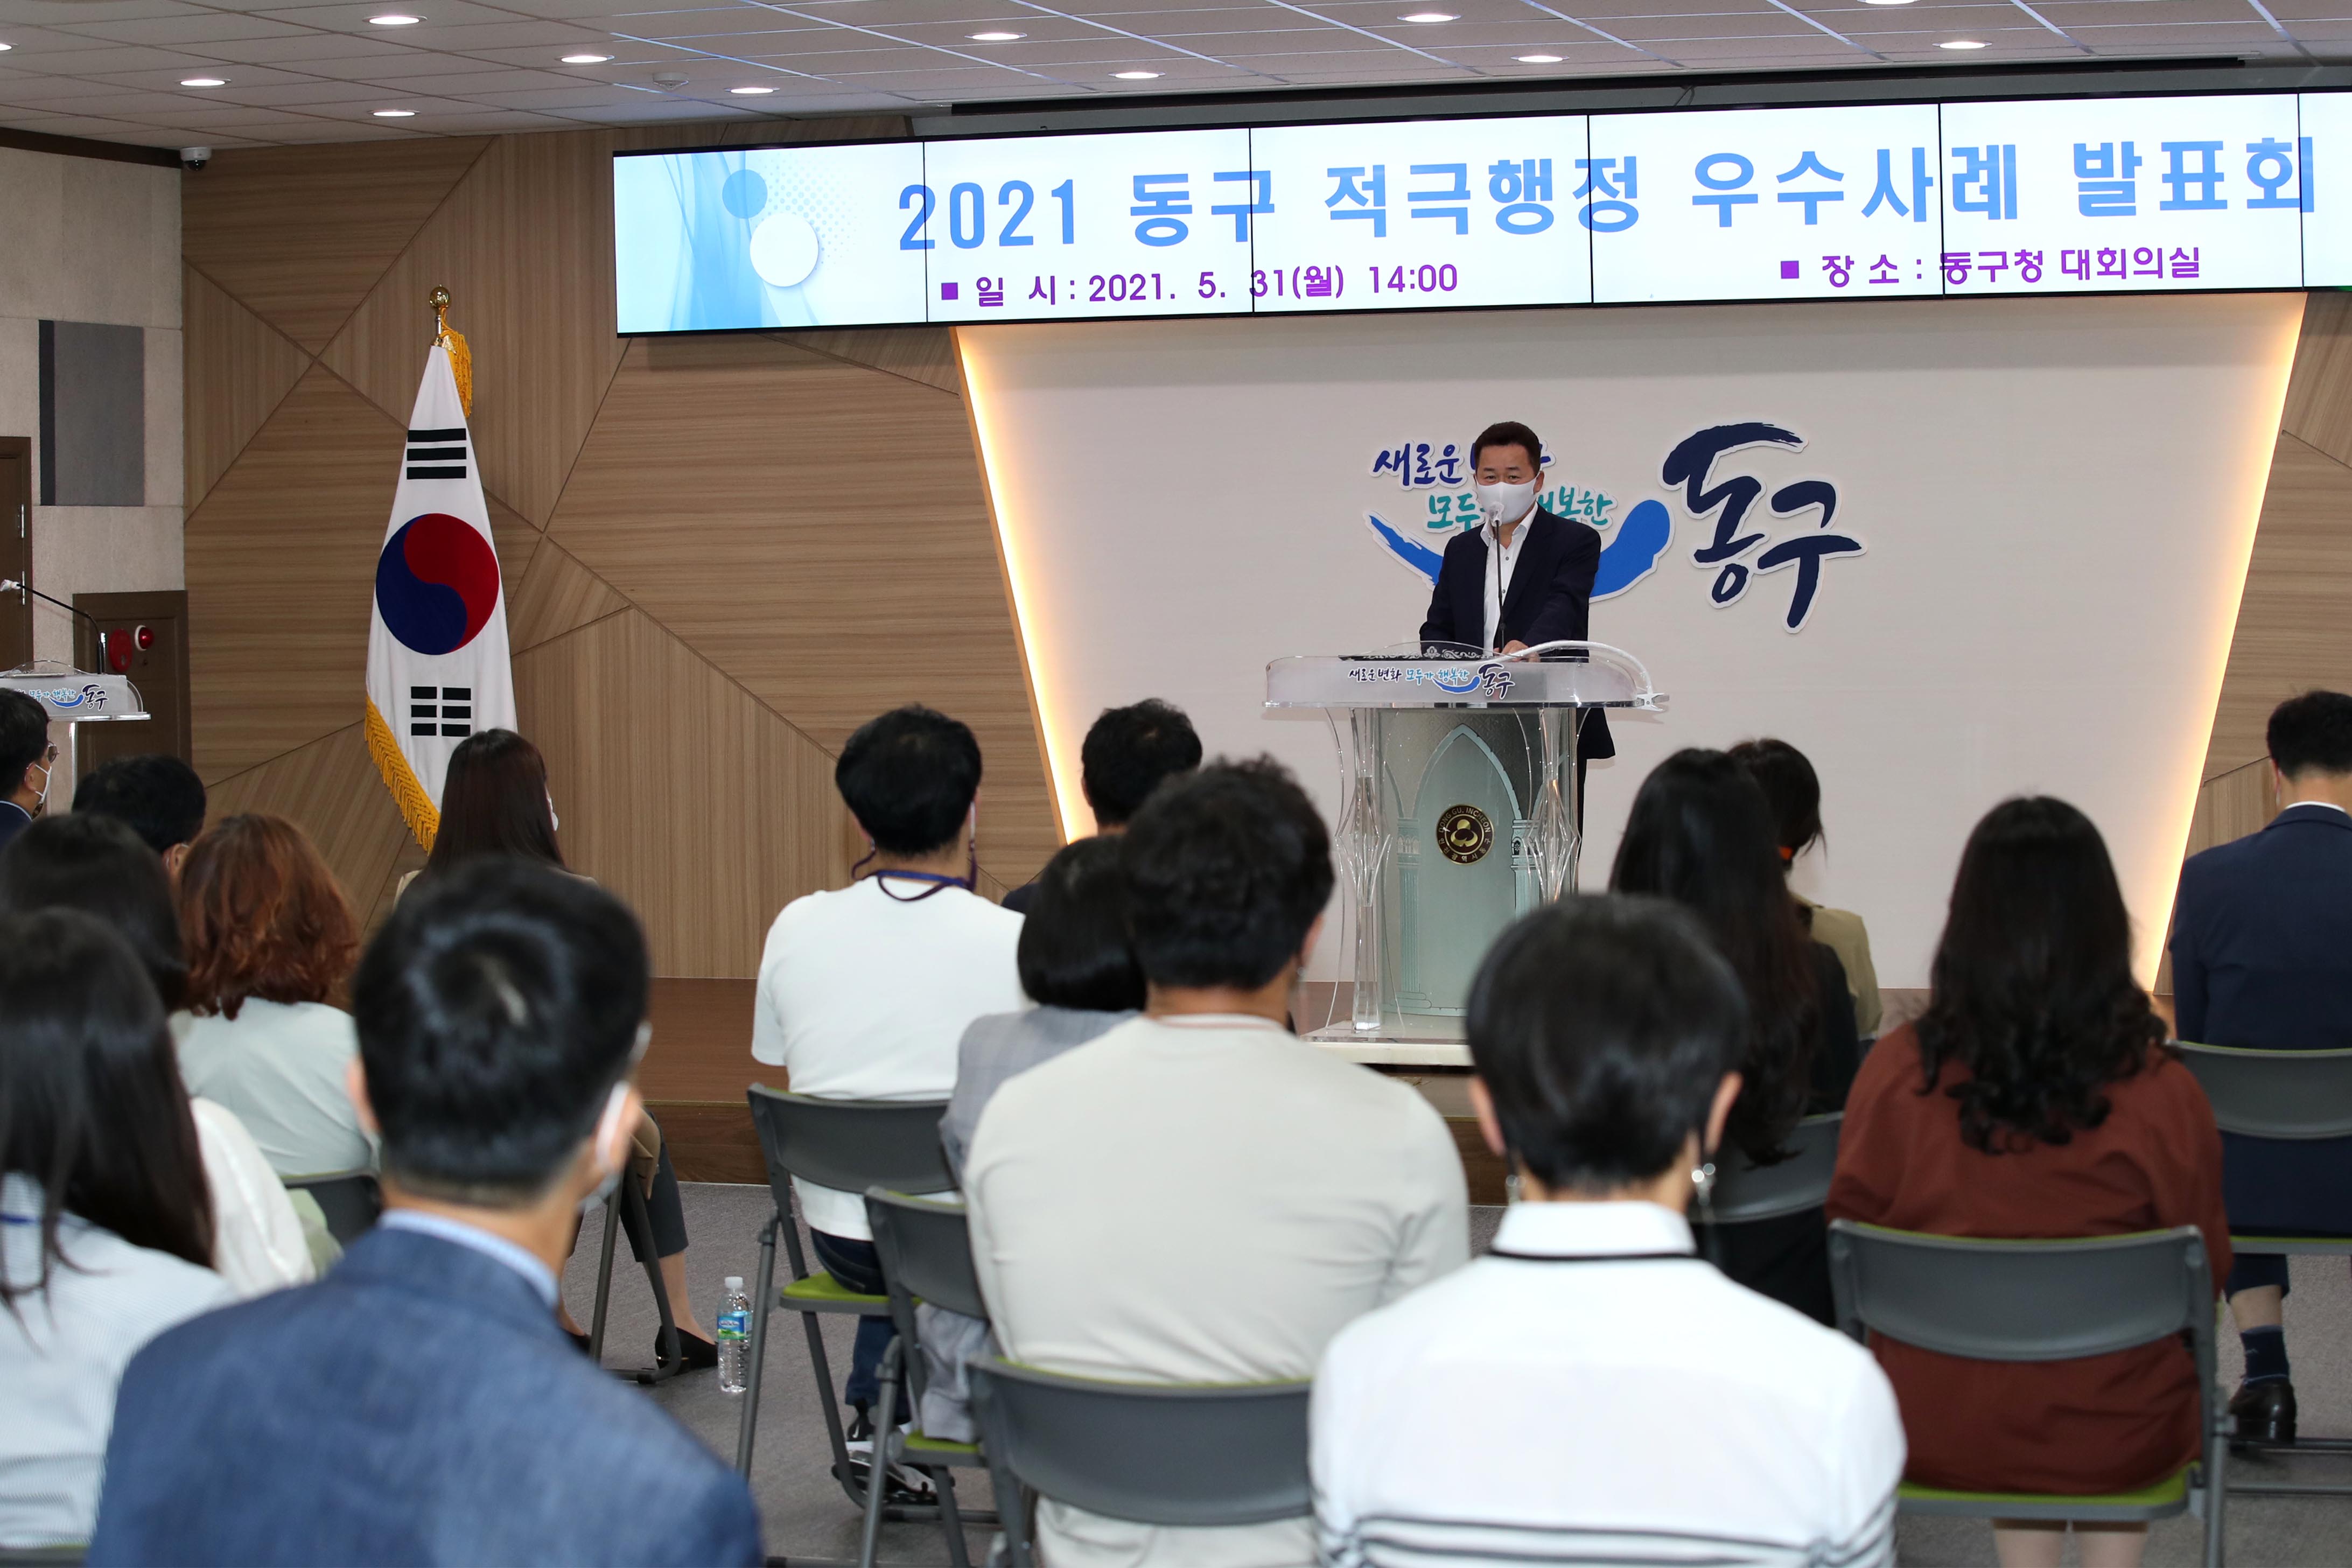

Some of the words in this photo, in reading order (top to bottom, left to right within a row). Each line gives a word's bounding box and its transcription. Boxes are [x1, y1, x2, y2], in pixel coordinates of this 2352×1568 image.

[899, 178, 1075, 250] 2021
[1130, 170, 1275, 247] 동구
[1324, 156, 1640, 238] 적극행정
[1692, 144, 2018, 228] 우수사례
[2073, 137, 2315, 217] 발표회
[976, 276, 1004, 307] 일
[1198, 271, 1226, 299] 5.
[1250, 265, 1344, 300] 31(월)
[1369, 264, 1458, 293] 14:00
[1822, 255, 1855, 288] 장
[1940, 249, 2044, 285] 동구청
[2061, 247, 2200, 281] 대회의실
[1373, 443, 1463, 486] 새로운
[1426, 492, 1487, 533] 모두
[1662, 422, 1863, 629] 동구
[53, 688, 76, 702] 행복한
[82, 684, 108, 710] 동구
[1406, 669, 1434, 684] 모두가
[1438, 668, 1469, 685] 행복한
[1479, 663, 1515, 698] 동구
[1438, 812, 1452, 833] DONG
[1466, 807, 1492, 833] INCHEON
